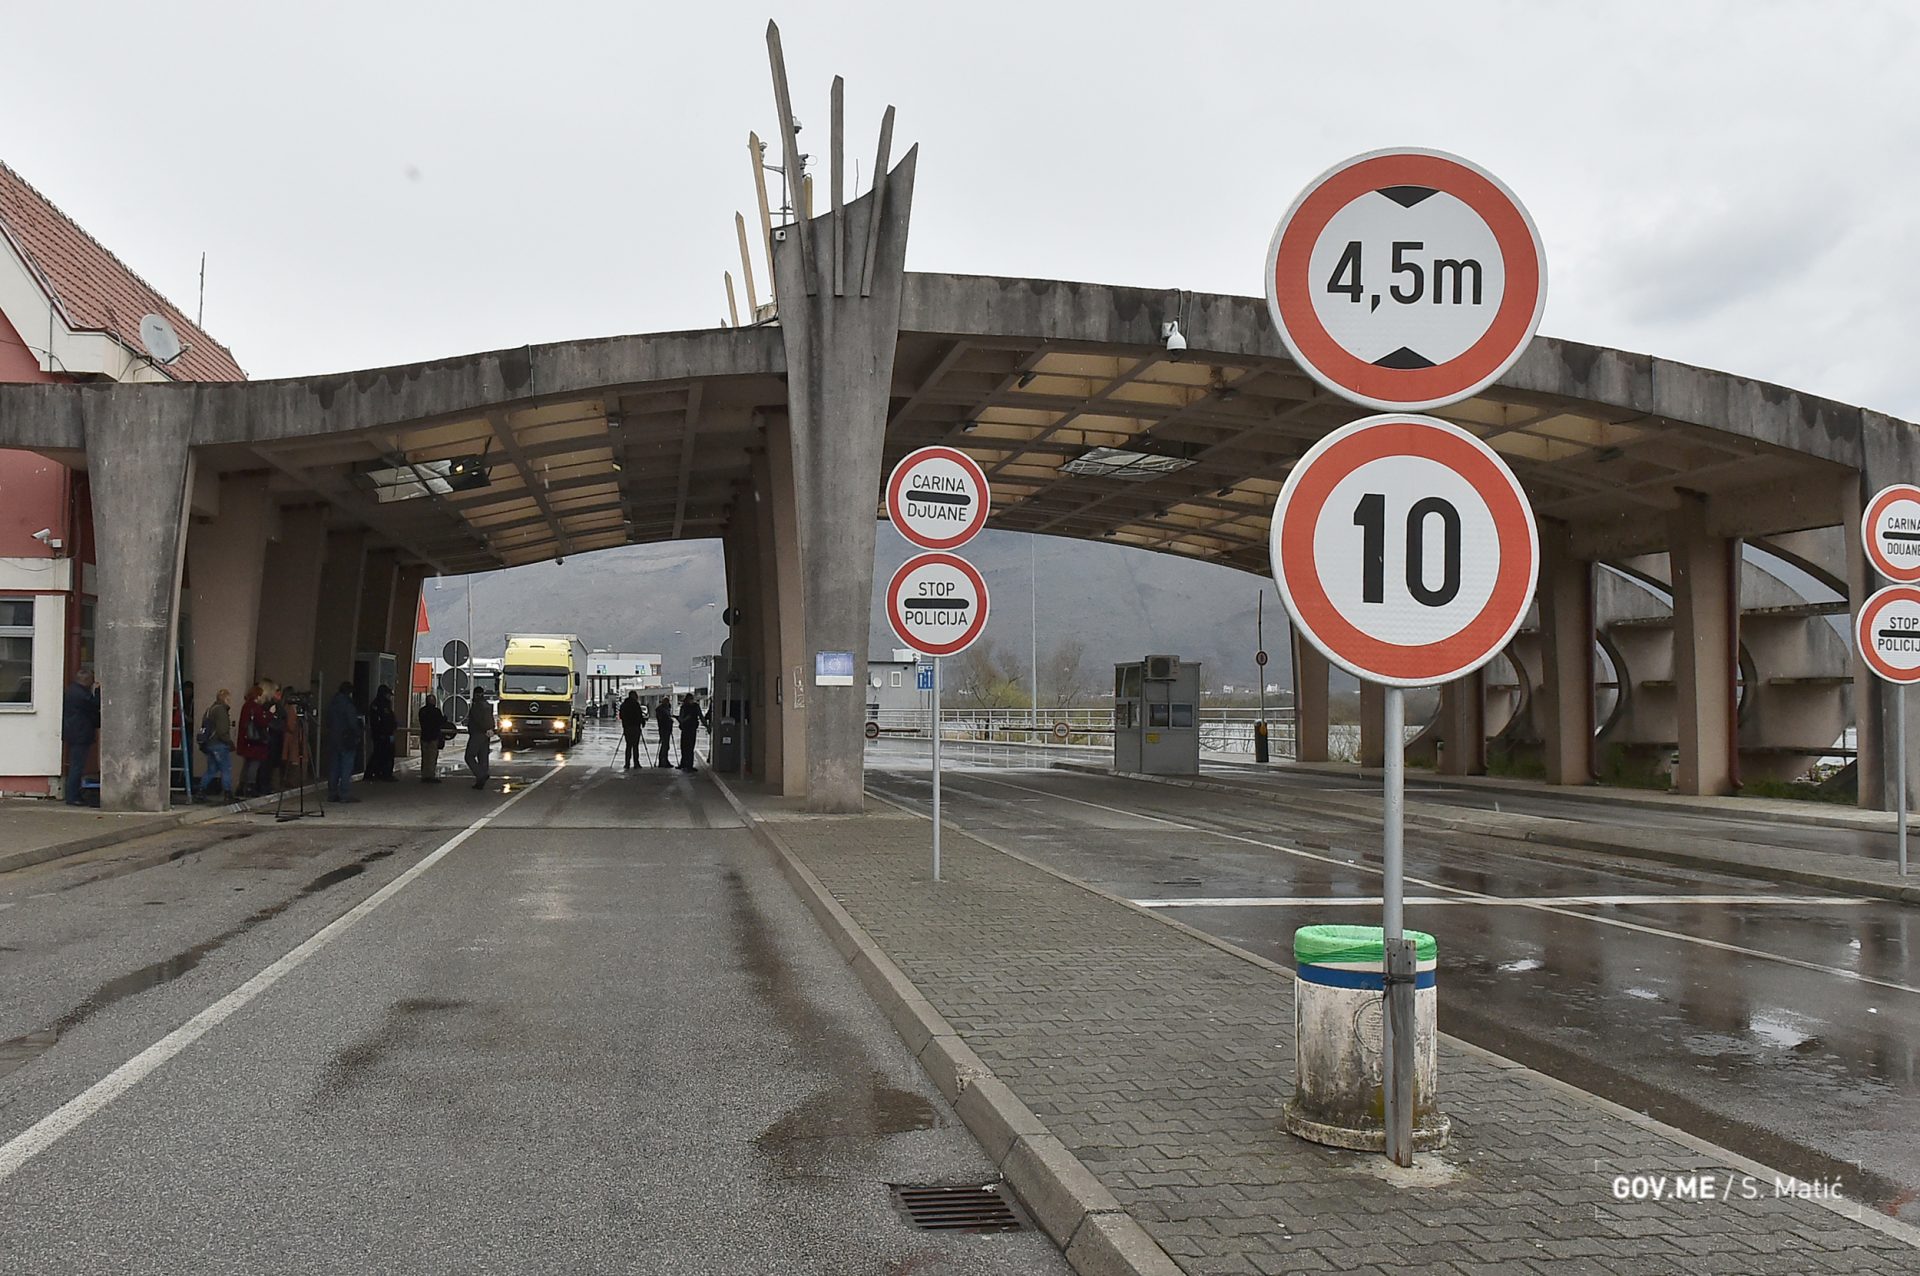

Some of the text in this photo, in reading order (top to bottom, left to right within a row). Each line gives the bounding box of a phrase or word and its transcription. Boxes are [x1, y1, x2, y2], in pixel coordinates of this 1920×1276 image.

[1326, 241, 1483, 314] 4,5m
[912, 474, 966, 493] CARINA
[1353, 493, 1461, 607] 10
[918, 582, 955, 597] STOP
[905, 610, 968, 626] POLICIJA
[1890, 616, 1919, 630] STOP
[1878, 638, 1920, 652] POLICIJ
